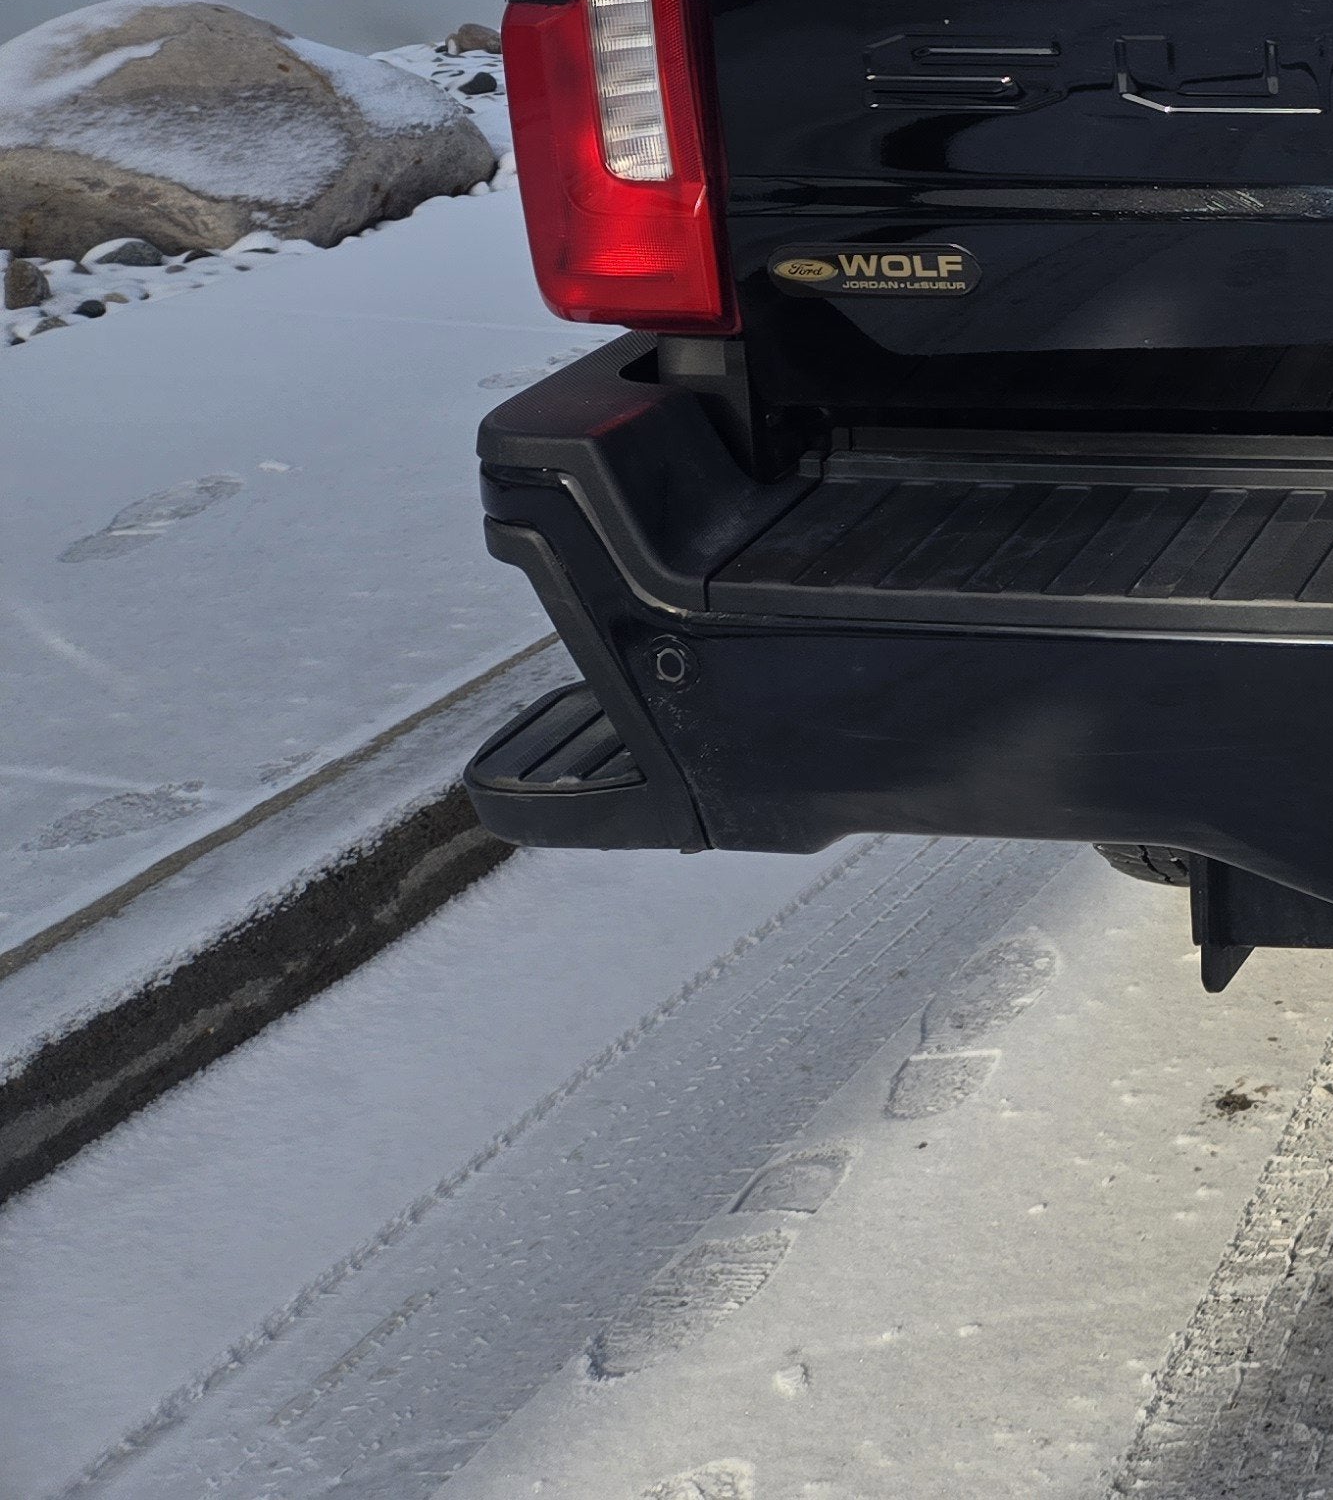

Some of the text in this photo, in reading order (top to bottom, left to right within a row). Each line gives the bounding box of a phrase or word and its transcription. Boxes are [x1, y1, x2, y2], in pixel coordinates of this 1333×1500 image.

[787, 254, 963, 277] Ford WOLF
[842, 281, 899, 289] JORDAN
